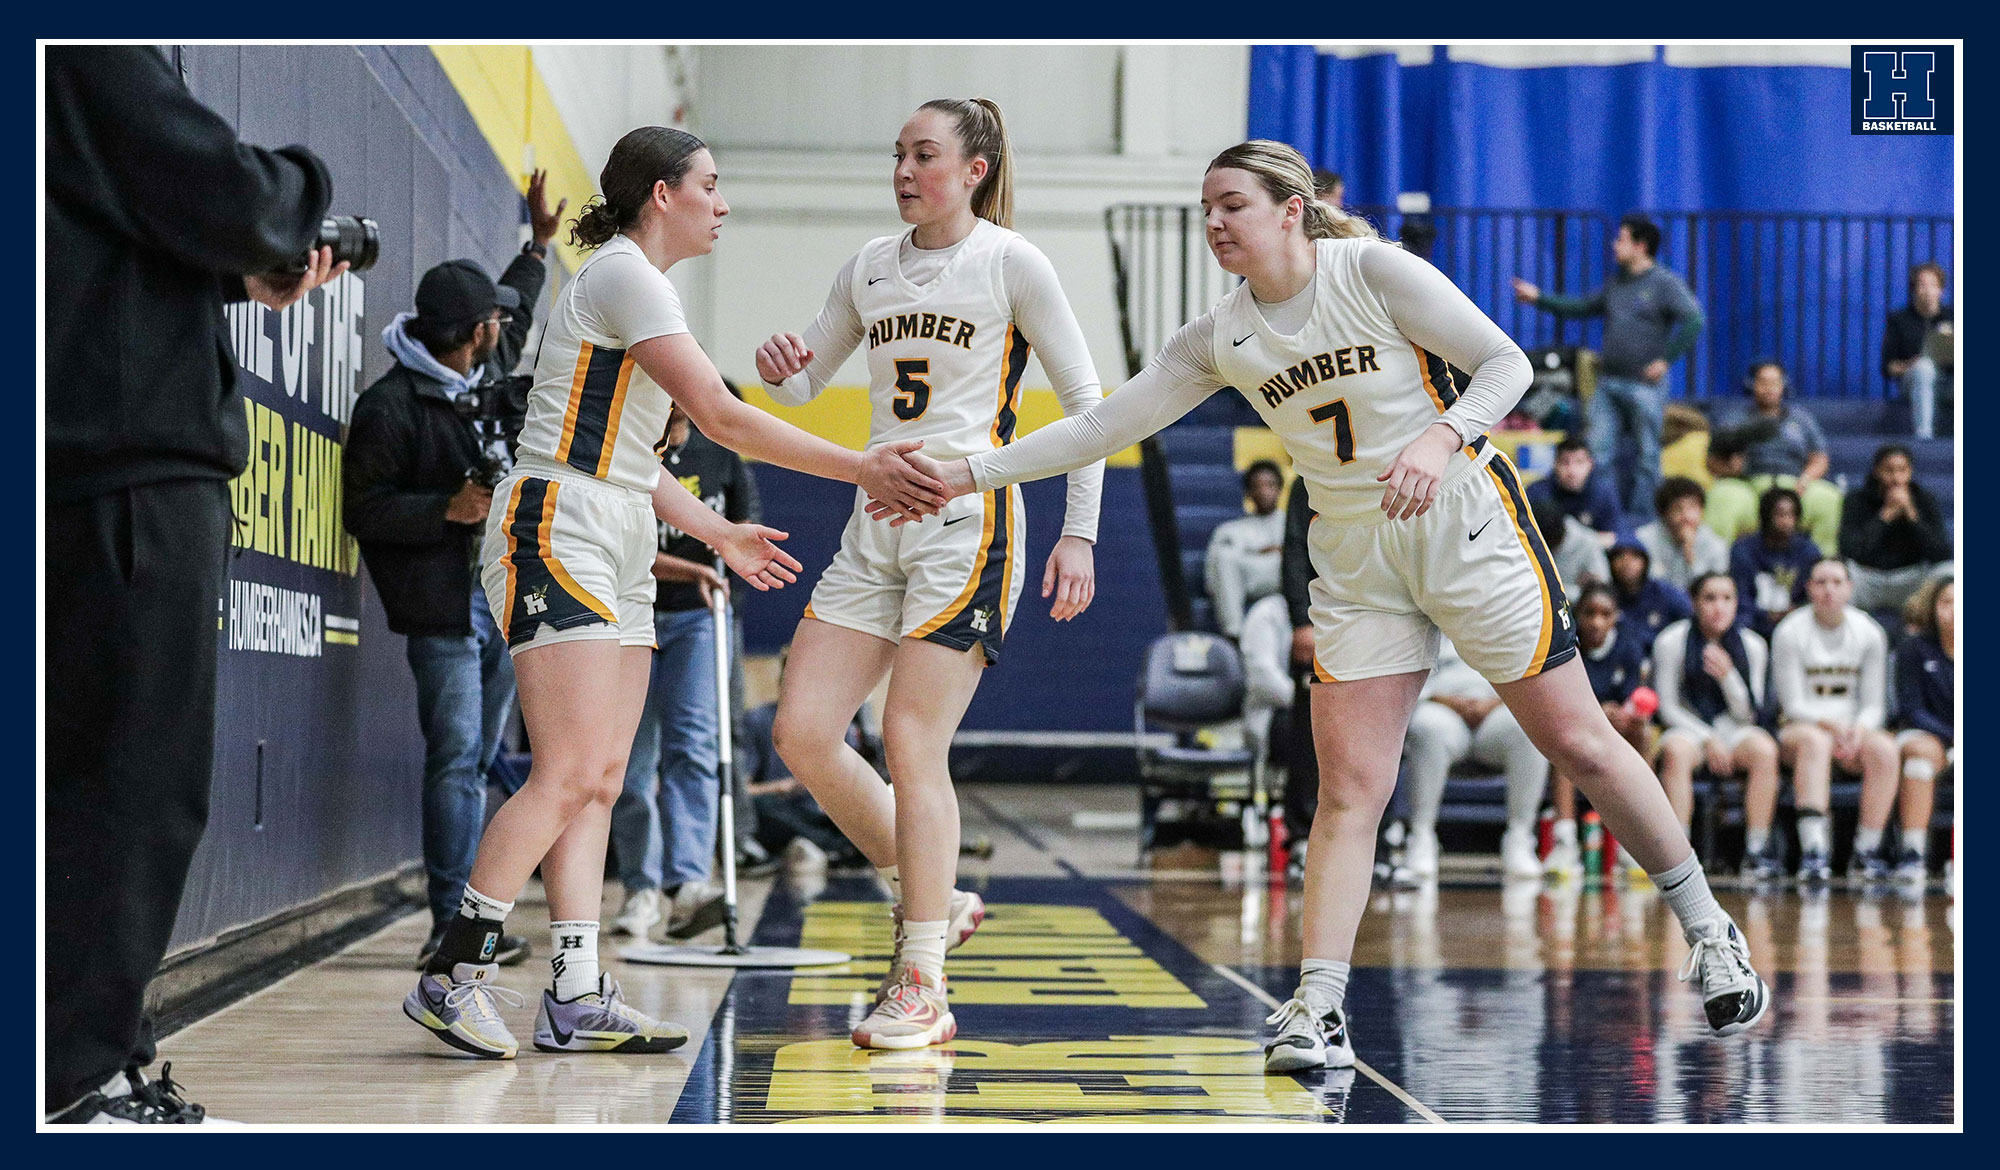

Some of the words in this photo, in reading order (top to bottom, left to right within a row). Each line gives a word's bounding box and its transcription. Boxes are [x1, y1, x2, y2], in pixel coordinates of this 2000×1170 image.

[281, 290, 315, 404] OF
[321, 268, 365, 425] THE
[868, 312, 976, 350] HUMBER
[892, 357, 933, 422] 5
[1258, 344, 1381, 409] HUMBER
[1306, 397, 1357, 466] 7
[227, 396, 287, 559] BER
[290, 421, 360, 577] HAW
[560, 935, 584, 949] H
